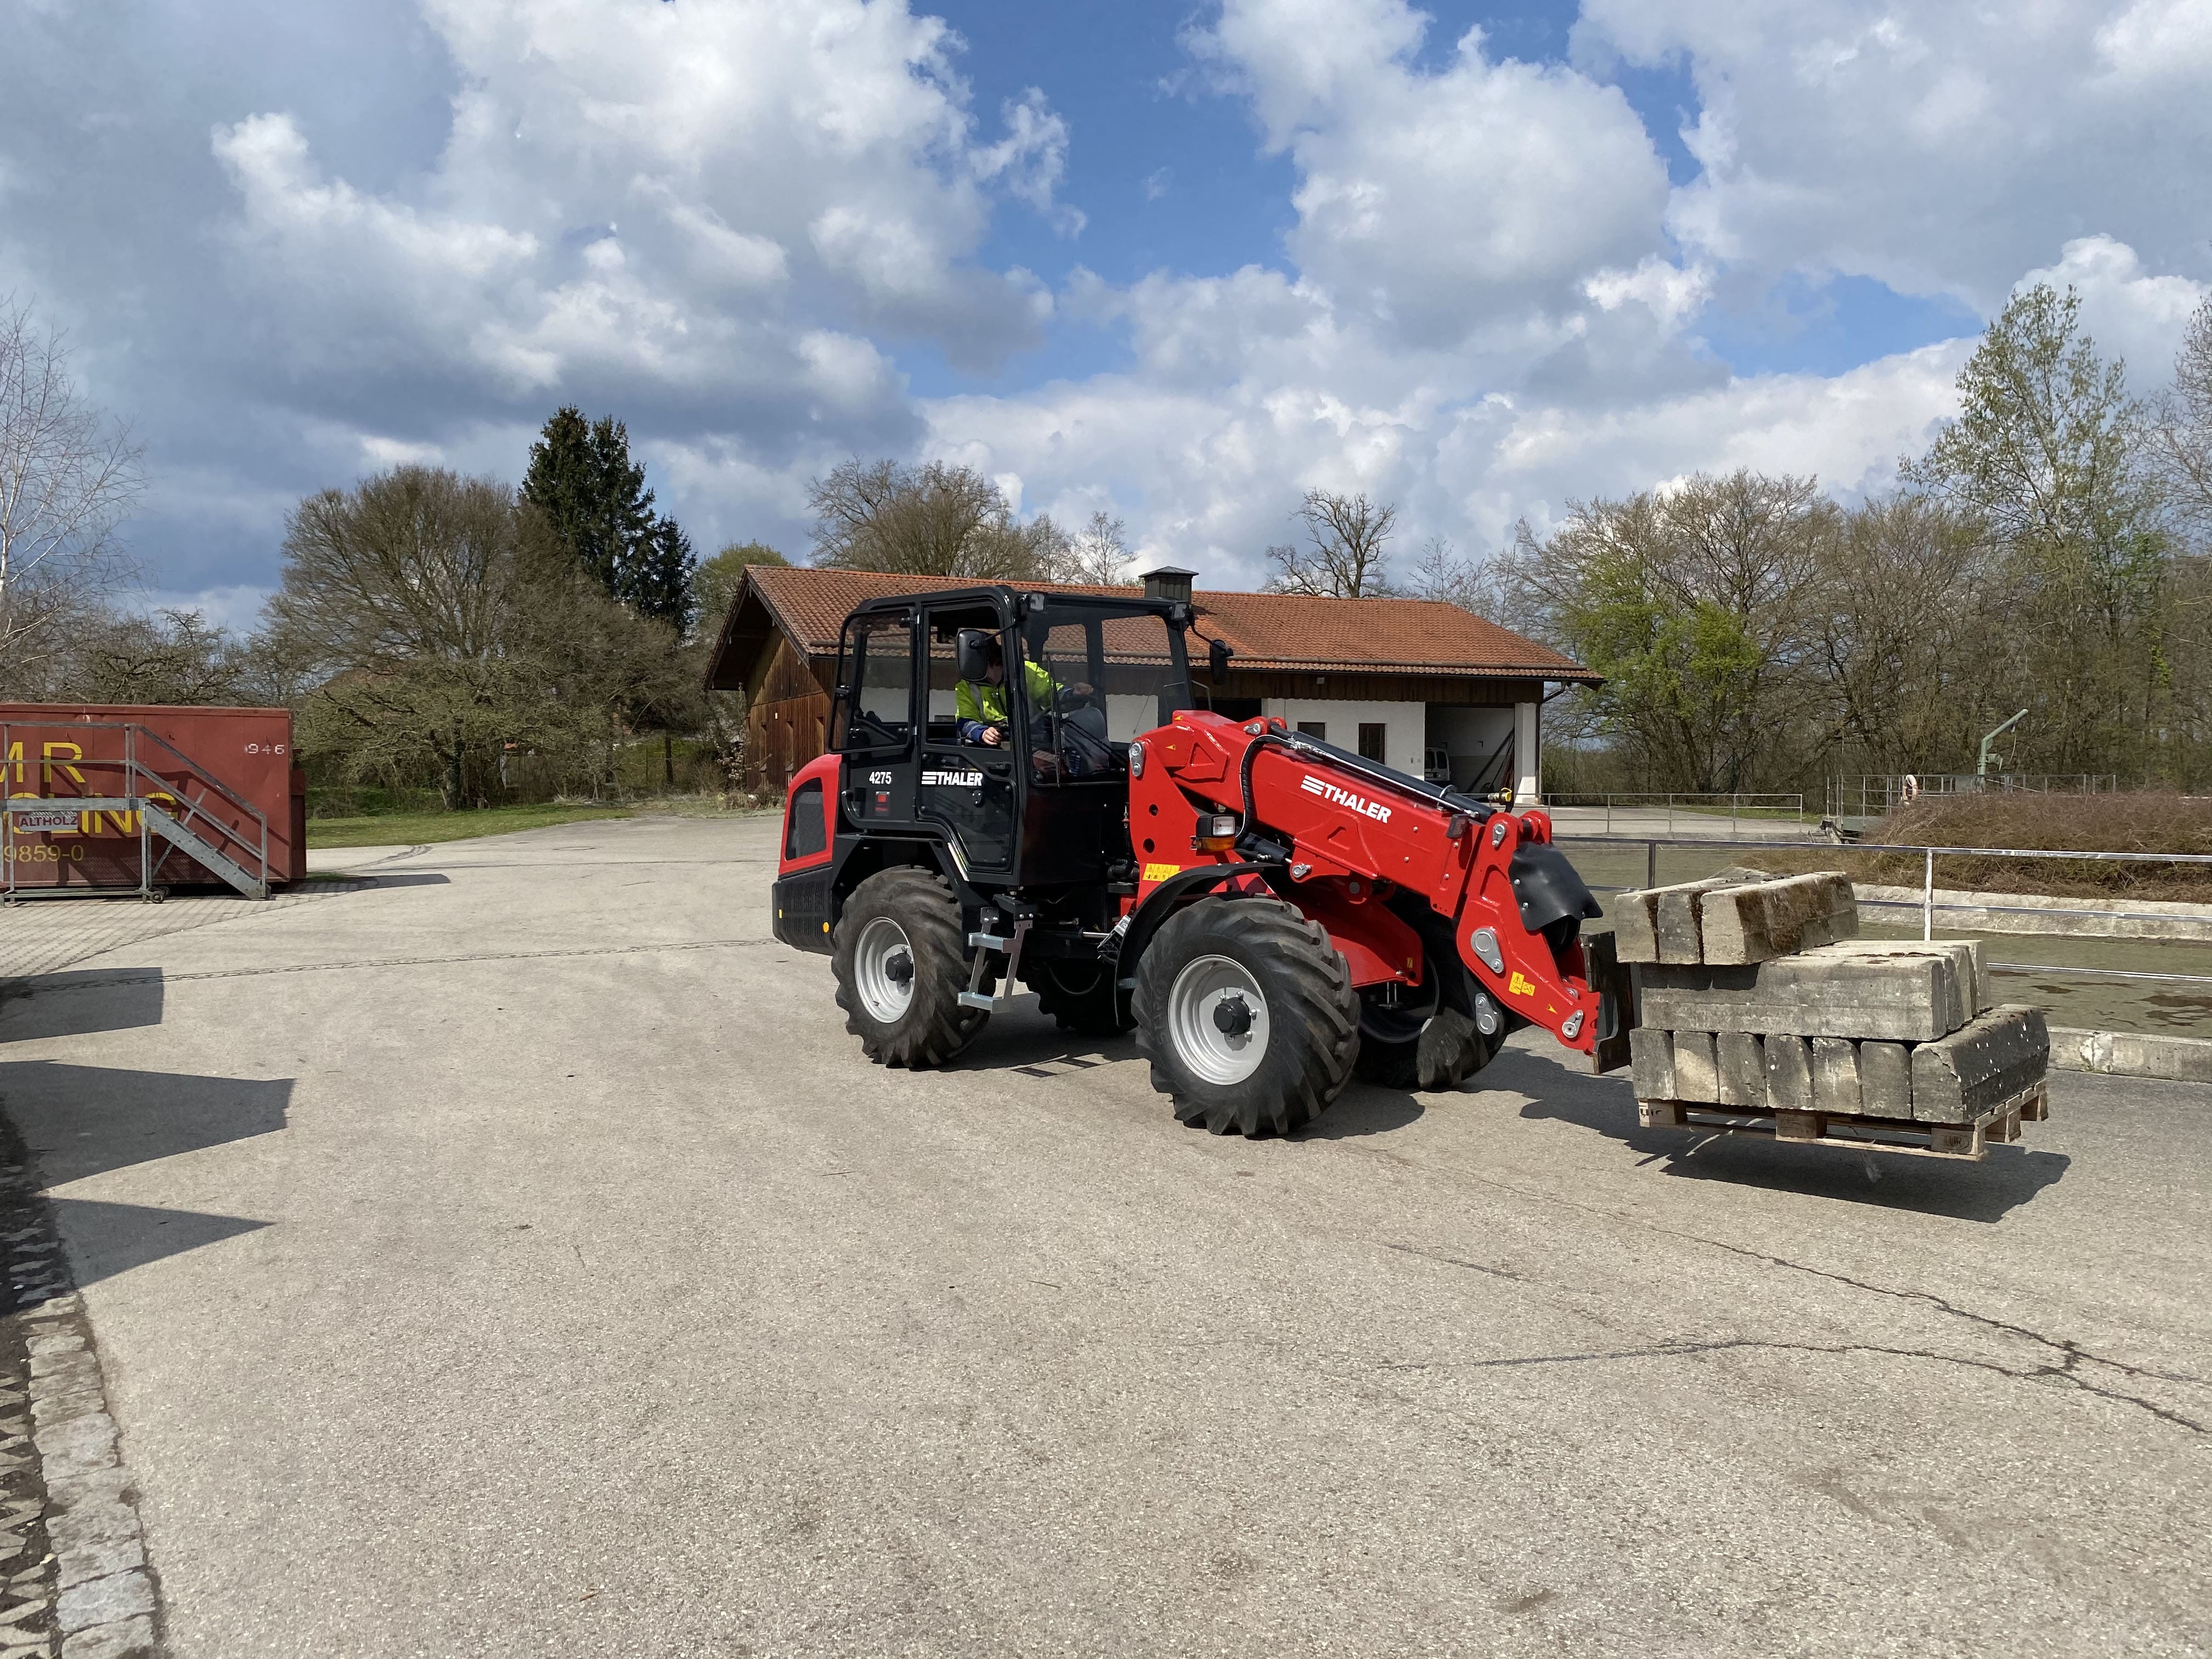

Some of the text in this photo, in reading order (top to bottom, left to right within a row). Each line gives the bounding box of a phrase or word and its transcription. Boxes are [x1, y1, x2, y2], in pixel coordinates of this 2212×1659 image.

[869, 771, 891, 785] 4275
[936, 771, 983, 786] THALER
[1324, 783, 1392, 823] THALER
[20, 816, 77, 827] ALTHOLZ
